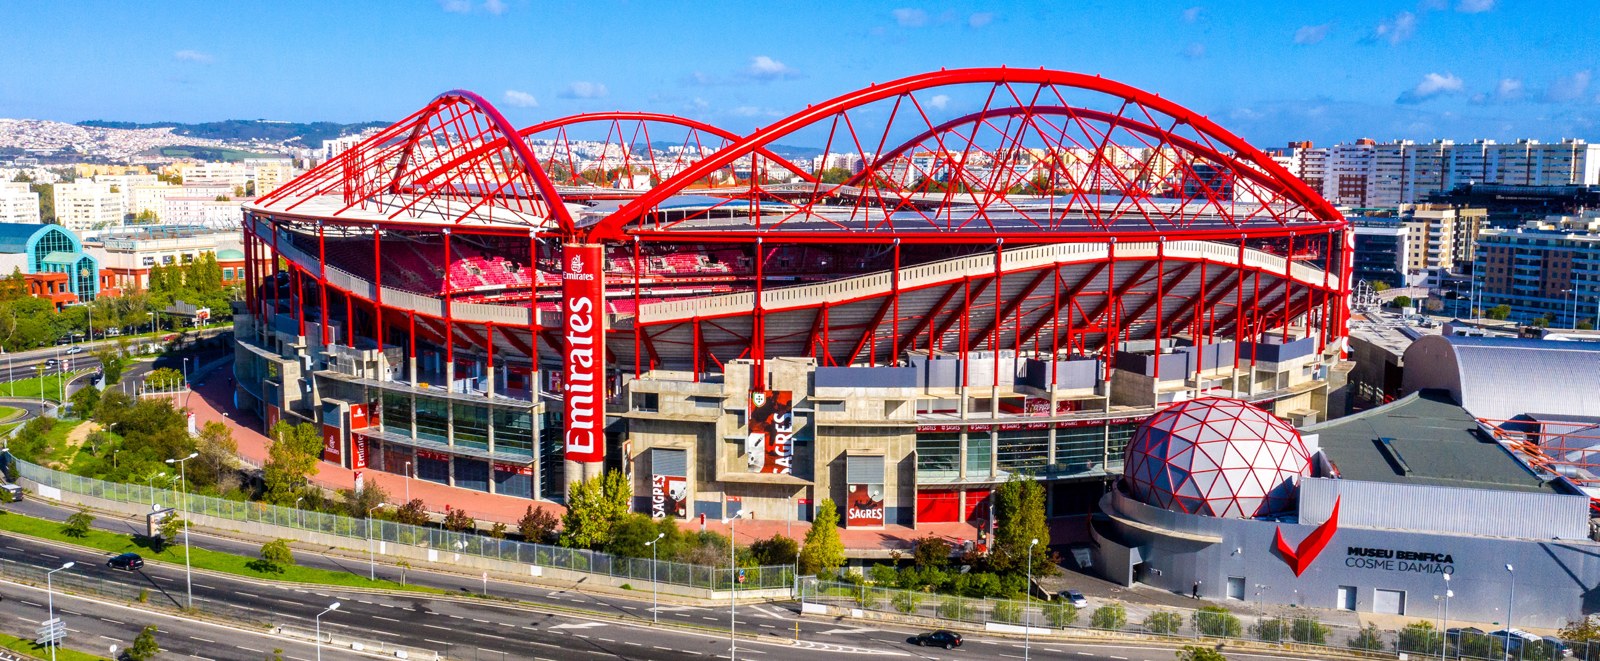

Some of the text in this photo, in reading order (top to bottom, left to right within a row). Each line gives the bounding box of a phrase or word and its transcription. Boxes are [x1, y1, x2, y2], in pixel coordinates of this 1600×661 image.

[562, 271, 594, 281] Emirates
[566, 296, 594, 454] Emirates
[773, 412, 793, 474] SAGRES
[652, 474, 666, 518] SAGRES
[849, 508, 882, 519] SAGRES
[1347, 547, 1454, 564] MUSEU BENFICA
[1345, 557, 1455, 575] COSME DAMIÃO
